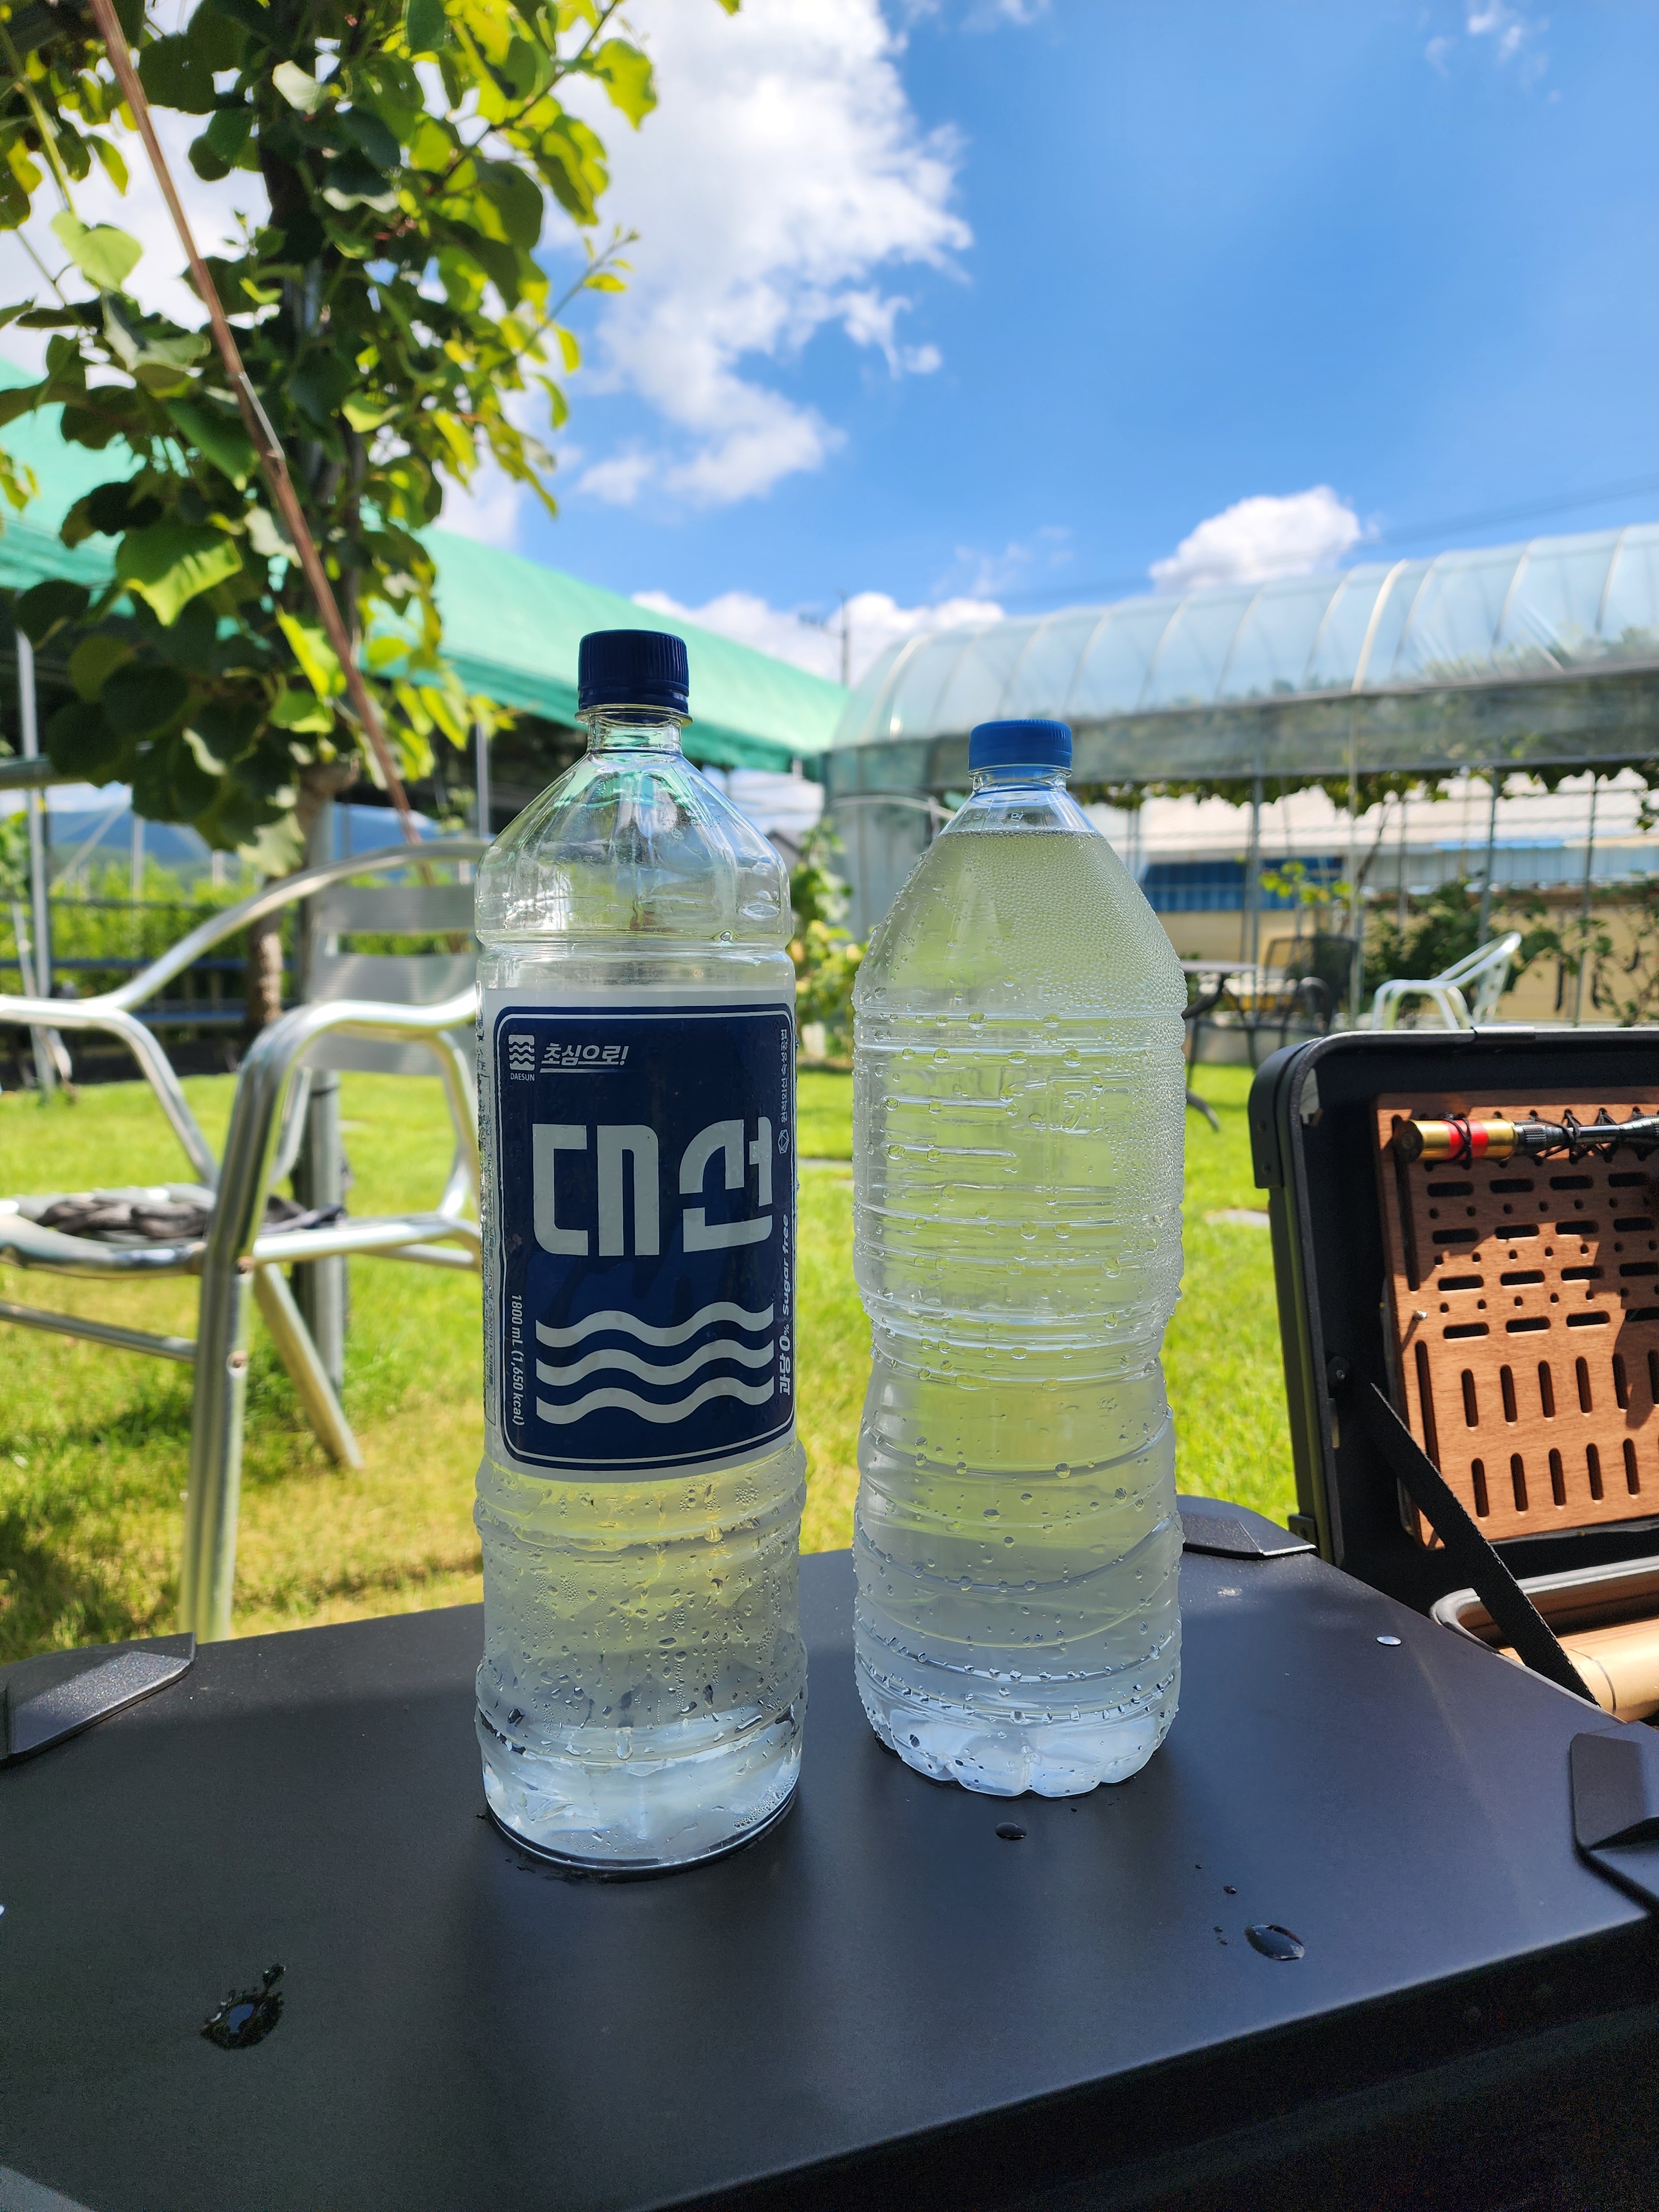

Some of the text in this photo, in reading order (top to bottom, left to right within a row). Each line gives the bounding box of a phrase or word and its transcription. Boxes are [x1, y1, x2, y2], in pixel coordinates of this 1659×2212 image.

[510, 1072, 535, 1082] DAESUN
[541, 1042, 629, 1066] 초심으로!
[532, 1116, 773, 1256] 대선
[510, 1295, 525, 1426] 1800 mL (1,650 kcal)
